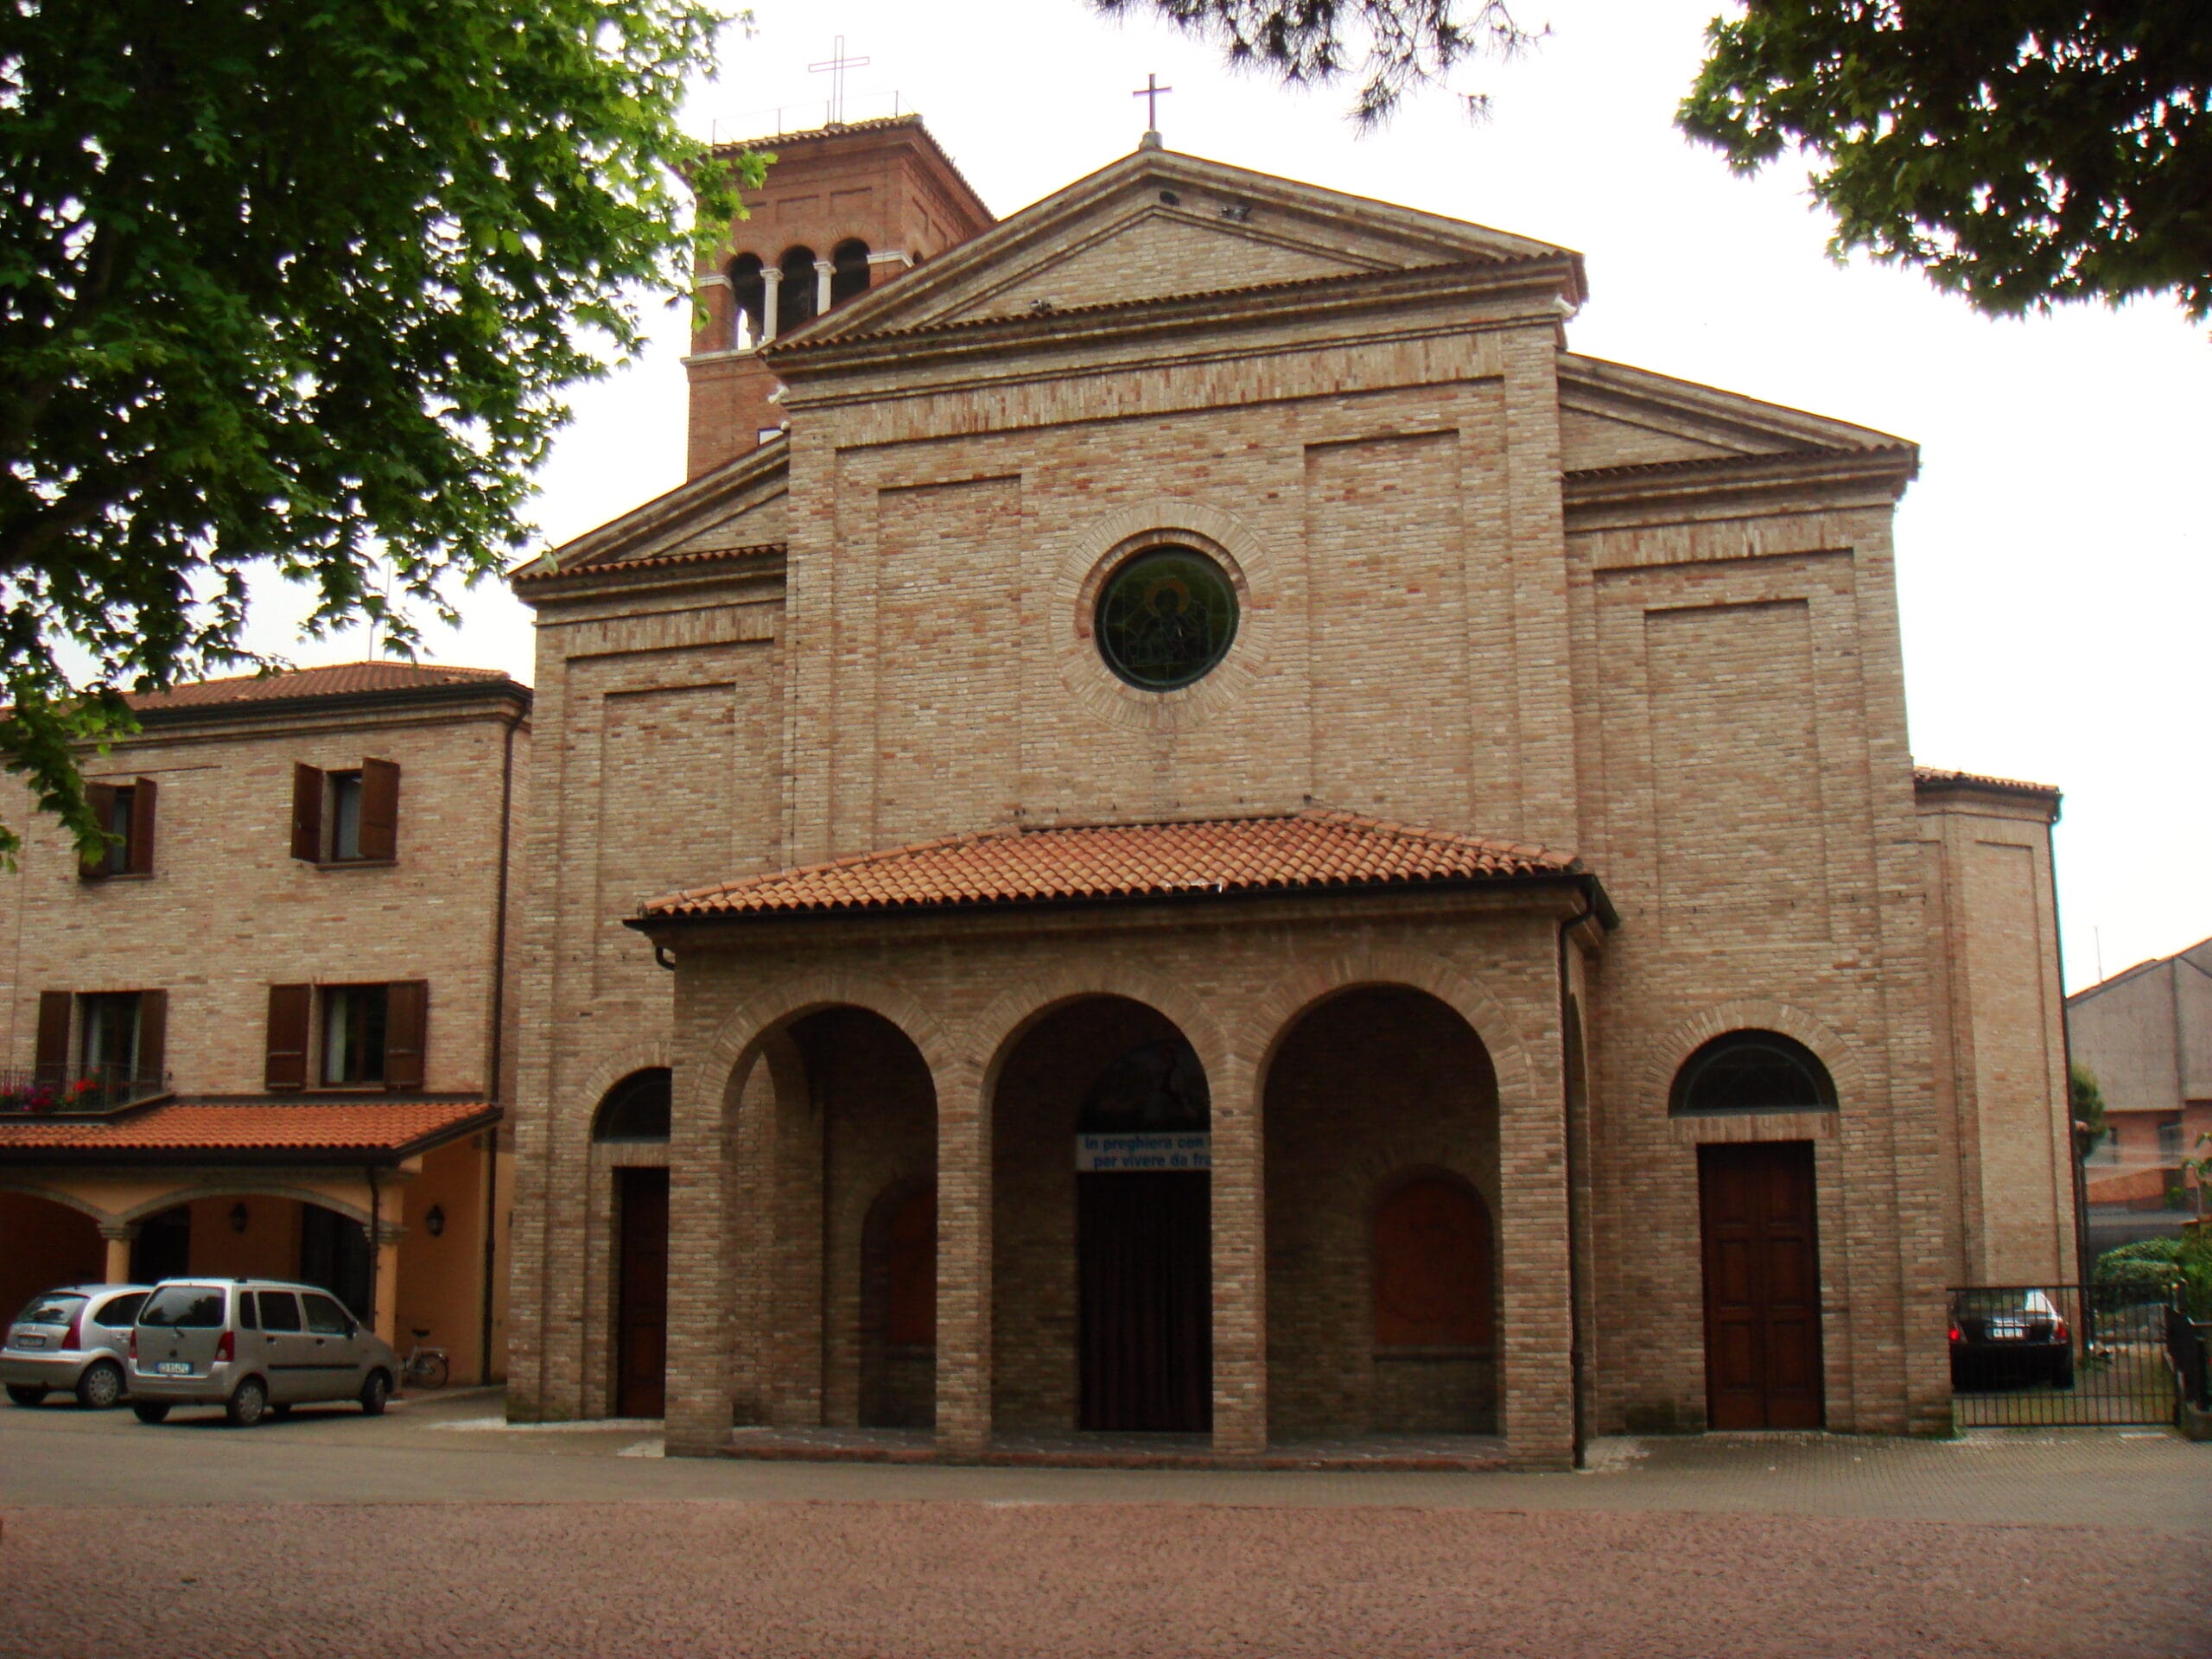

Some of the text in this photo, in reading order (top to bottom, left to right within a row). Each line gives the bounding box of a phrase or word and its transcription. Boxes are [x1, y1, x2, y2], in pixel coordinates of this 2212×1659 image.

[1085, 1135, 1097, 1149] In
[1103, 1137, 1172, 1152] preghiera
[1178, 1139, 1203, 1149] con
[1094, 1156, 1117, 1171] per
[1122, 1154, 1165, 1166] vivere
[1171, 1154, 1188, 1166] da
